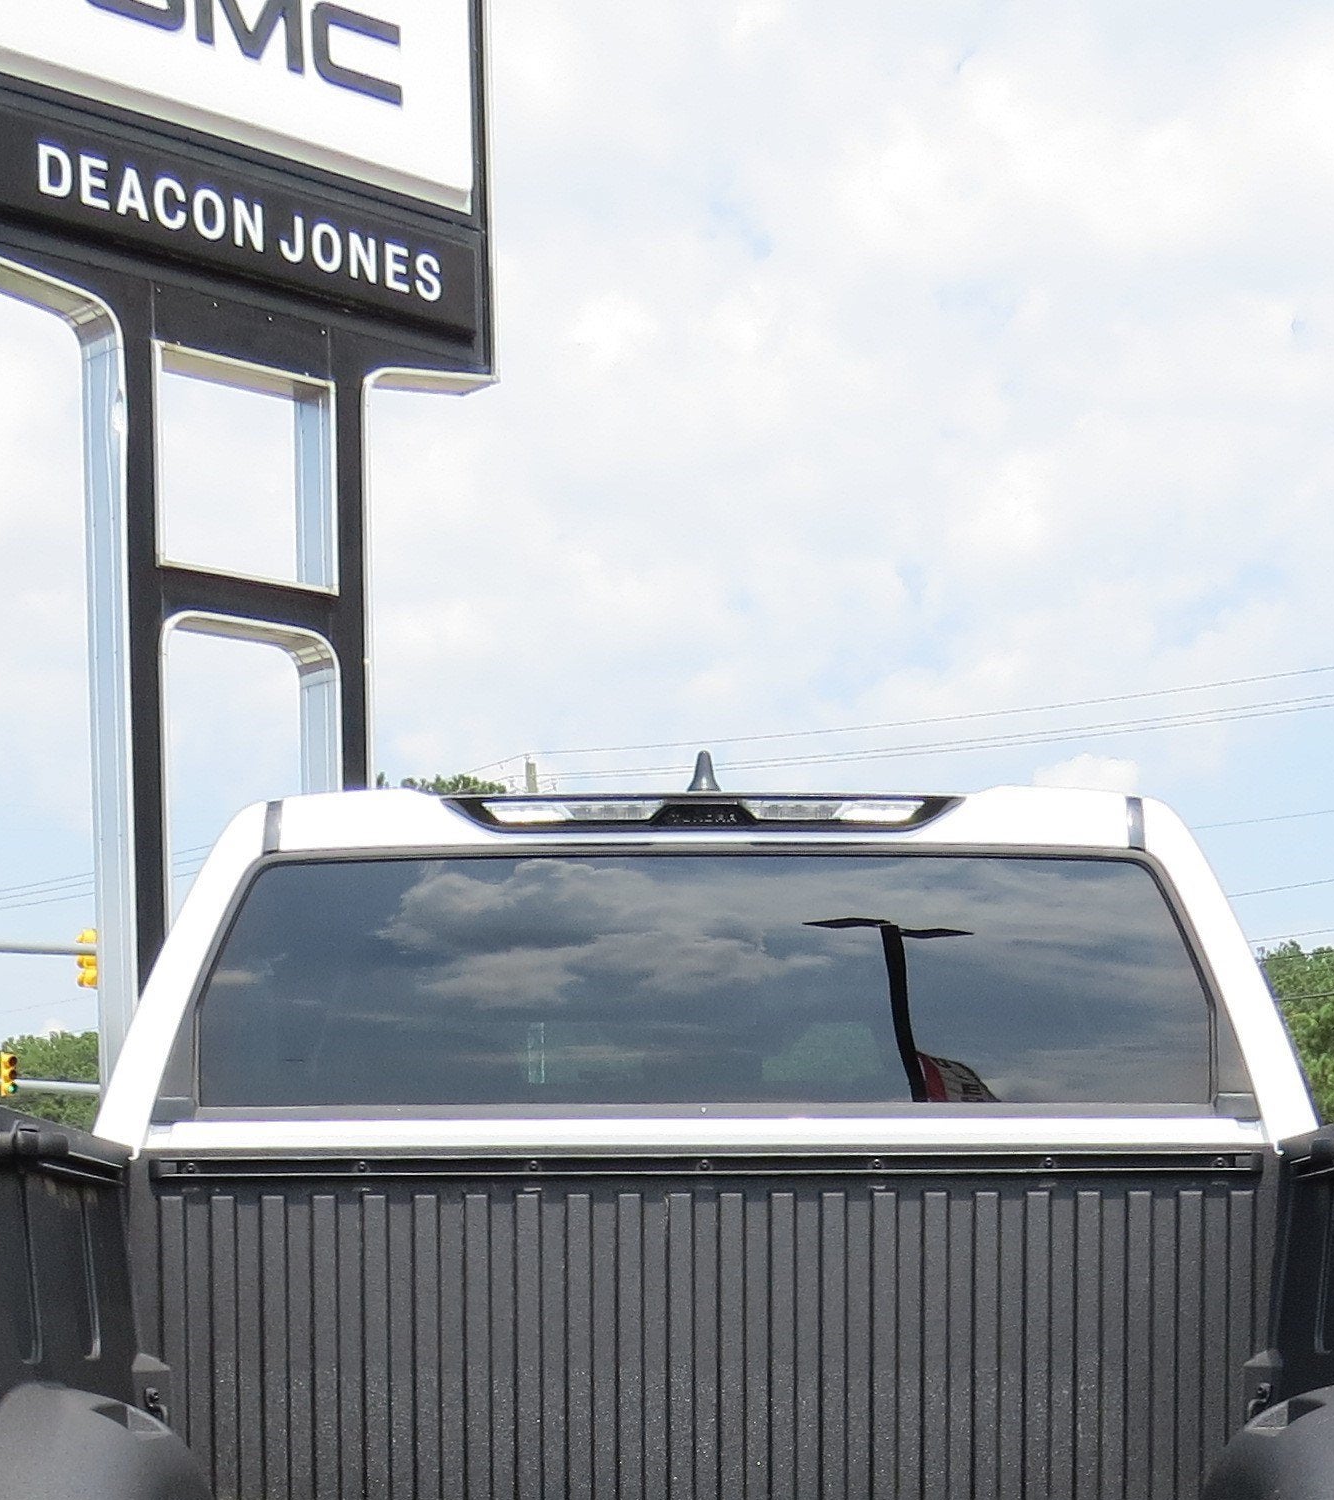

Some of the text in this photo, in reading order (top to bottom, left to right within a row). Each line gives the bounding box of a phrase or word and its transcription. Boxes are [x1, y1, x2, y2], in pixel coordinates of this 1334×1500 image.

[85, 0, 402, 106] MC
[37, 143, 443, 302] DEACON JONES
